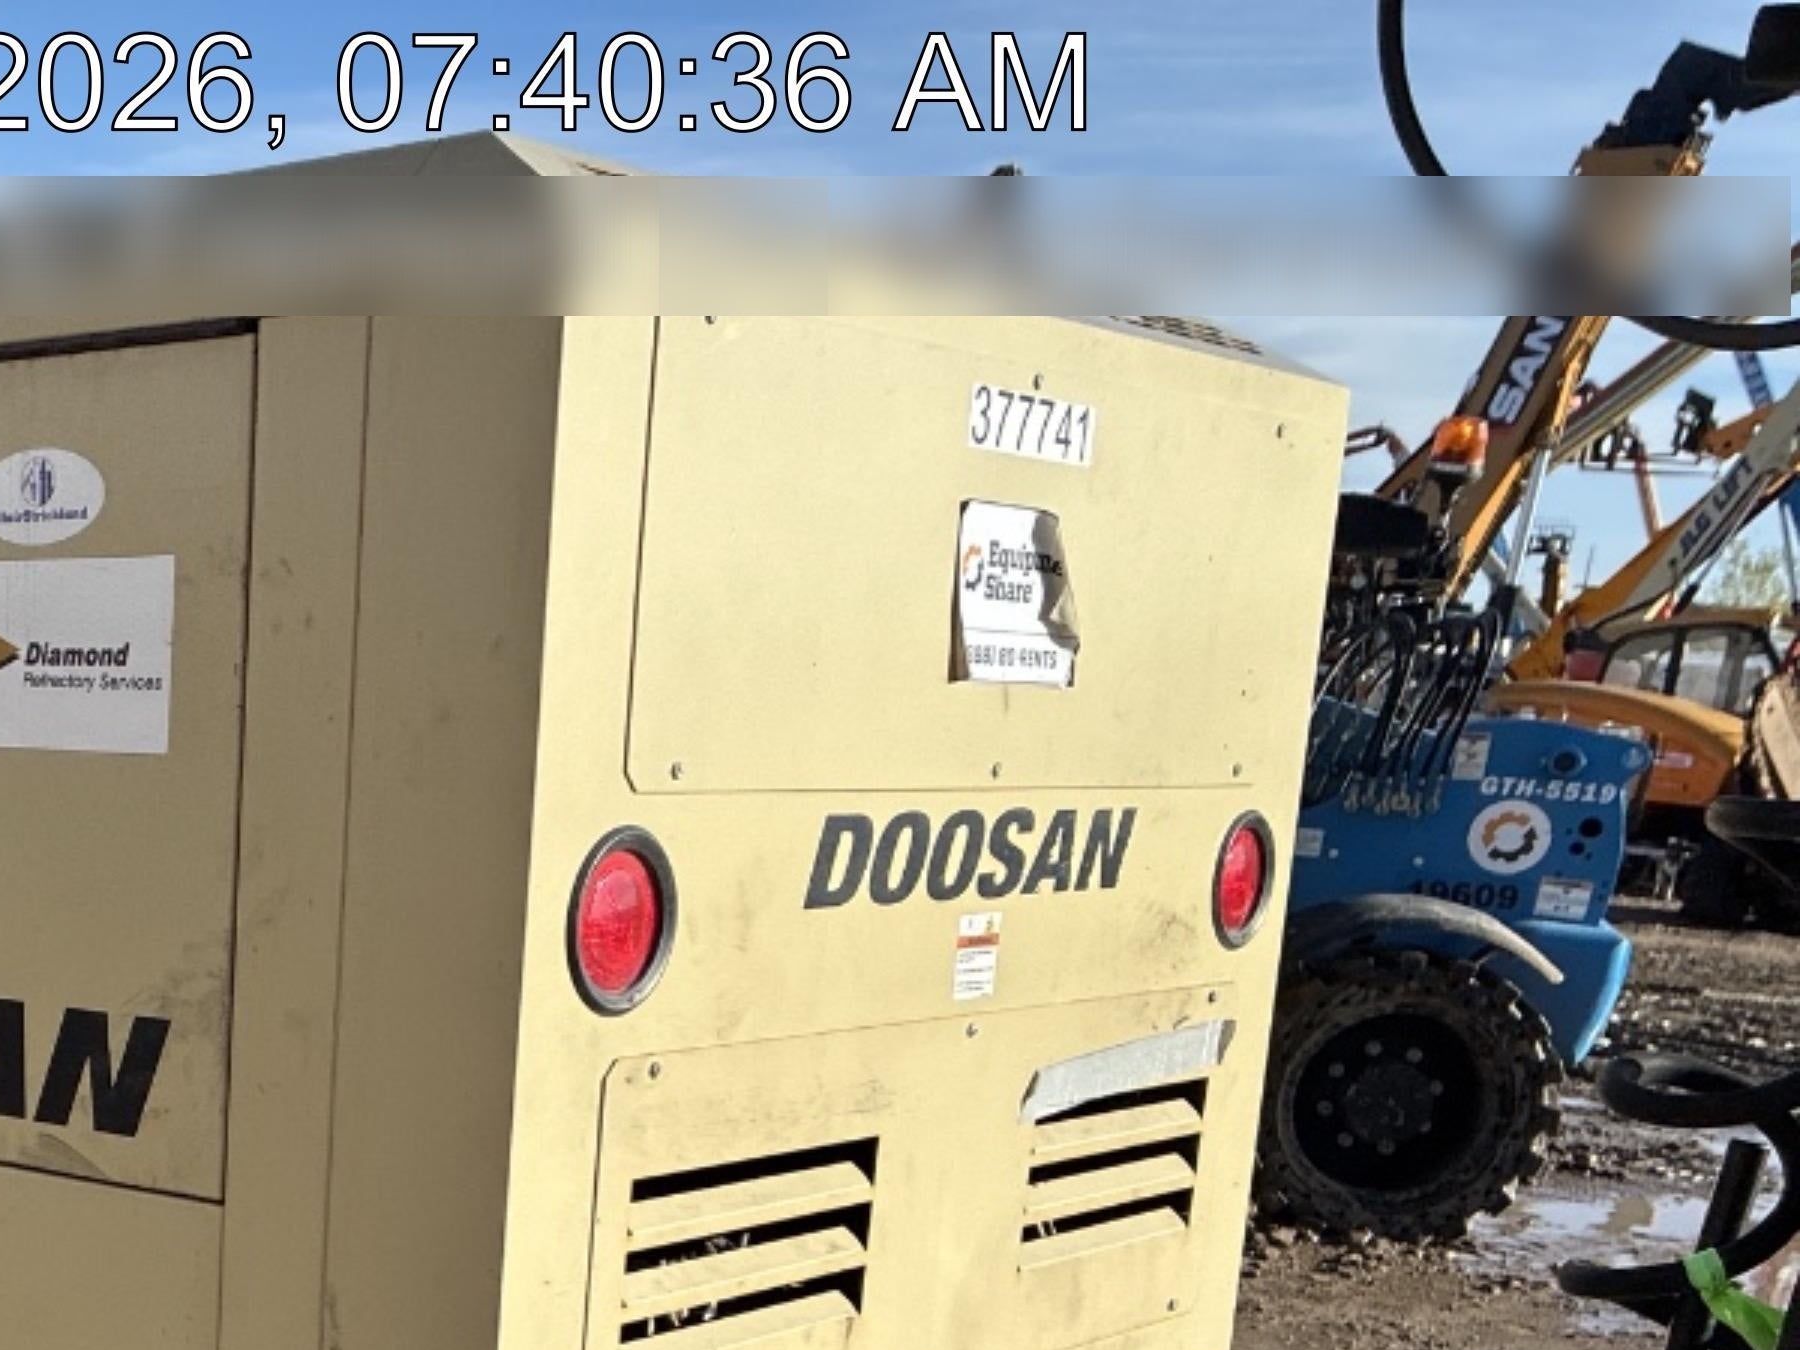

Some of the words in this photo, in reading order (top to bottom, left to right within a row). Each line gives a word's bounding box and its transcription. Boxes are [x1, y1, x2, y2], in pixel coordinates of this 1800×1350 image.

[971, 385, 1090, 462] 377741
[24, 641, 130, 667] Diamond
[23, 671, 95, 693] Refractory
[98, 671, 163, 691] Services
[1479, 775, 1617, 805] GTH-5519
[802, 806, 1138, 910] DOOSAN
